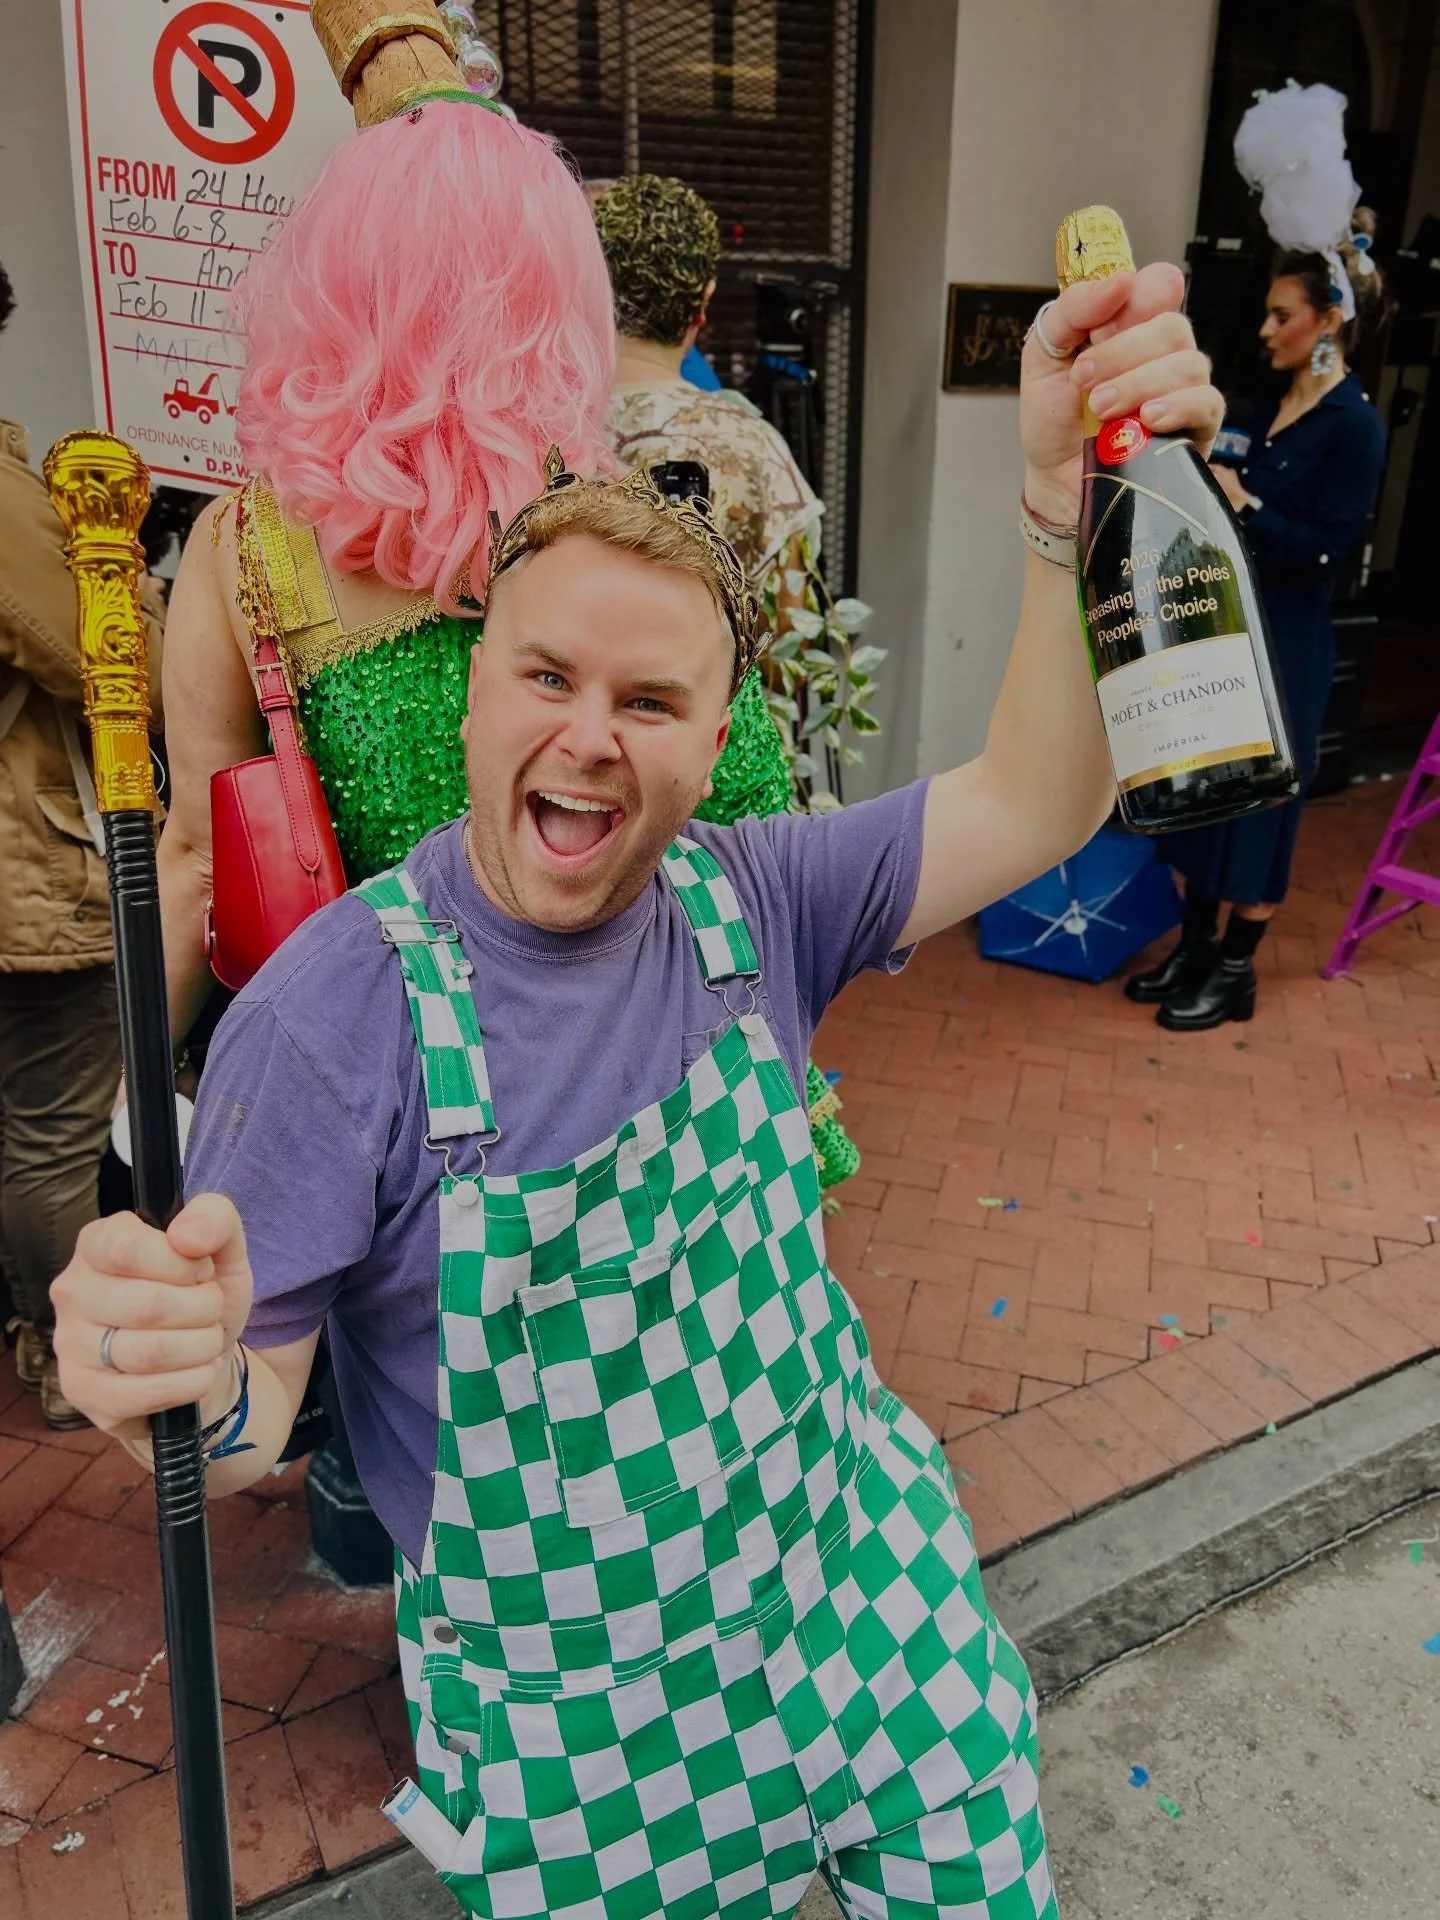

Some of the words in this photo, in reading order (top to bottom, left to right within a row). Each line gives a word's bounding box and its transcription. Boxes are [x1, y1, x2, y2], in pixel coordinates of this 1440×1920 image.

[97, 156, 176, 201] FROM
[185, 168, 227, 206] 24
[108, 198, 158, 234] Feb
[104, 240, 137, 278] TO
[117, 280, 168, 318] Feb
[126, 424, 209, 452] ORDINANCE
[1156, 574, 1184, 594] the
[1187, 564, 1231, 586] Poles
[1097, 611, 1157, 648] People's
[1160, 596, 1218, 622] Choice
[1147, 699, 1158, 713] &
[1162, 676, 1246, 706] CHANDON
